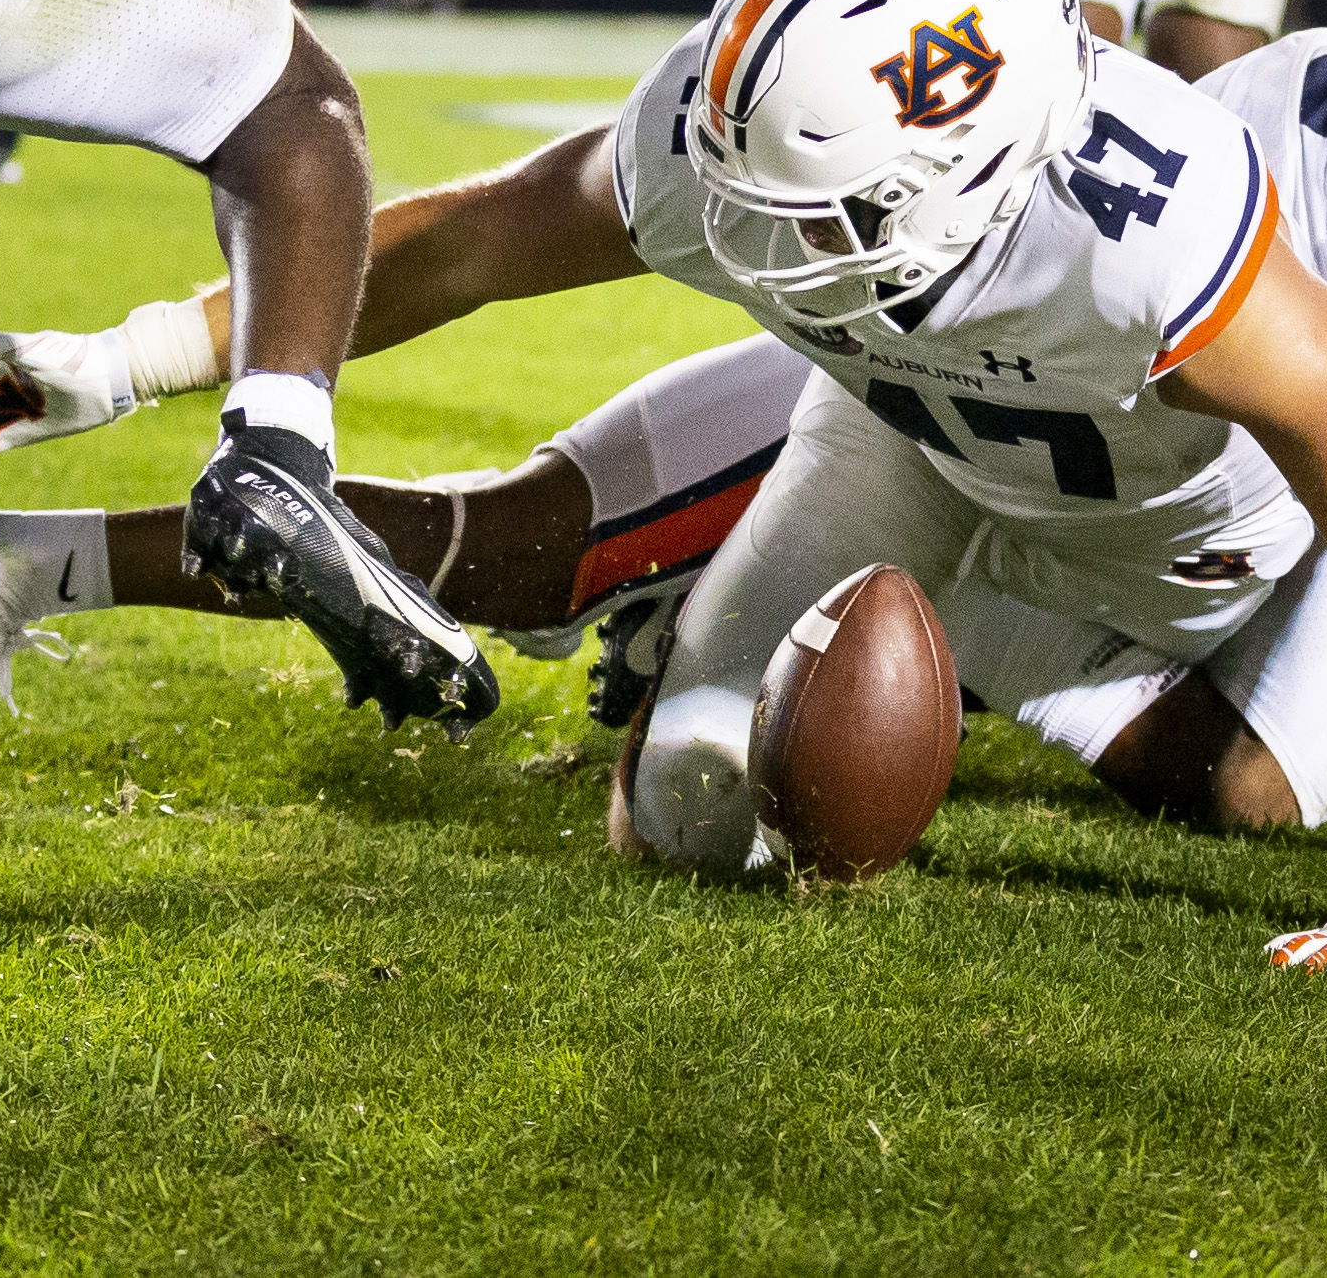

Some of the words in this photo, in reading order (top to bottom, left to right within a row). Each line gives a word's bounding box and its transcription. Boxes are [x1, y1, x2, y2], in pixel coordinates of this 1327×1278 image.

[1067, 109, 1188, 243] 47
[868, 353, 985, 393] AUBURN
[235, 471, 314, 525] VAPOR
